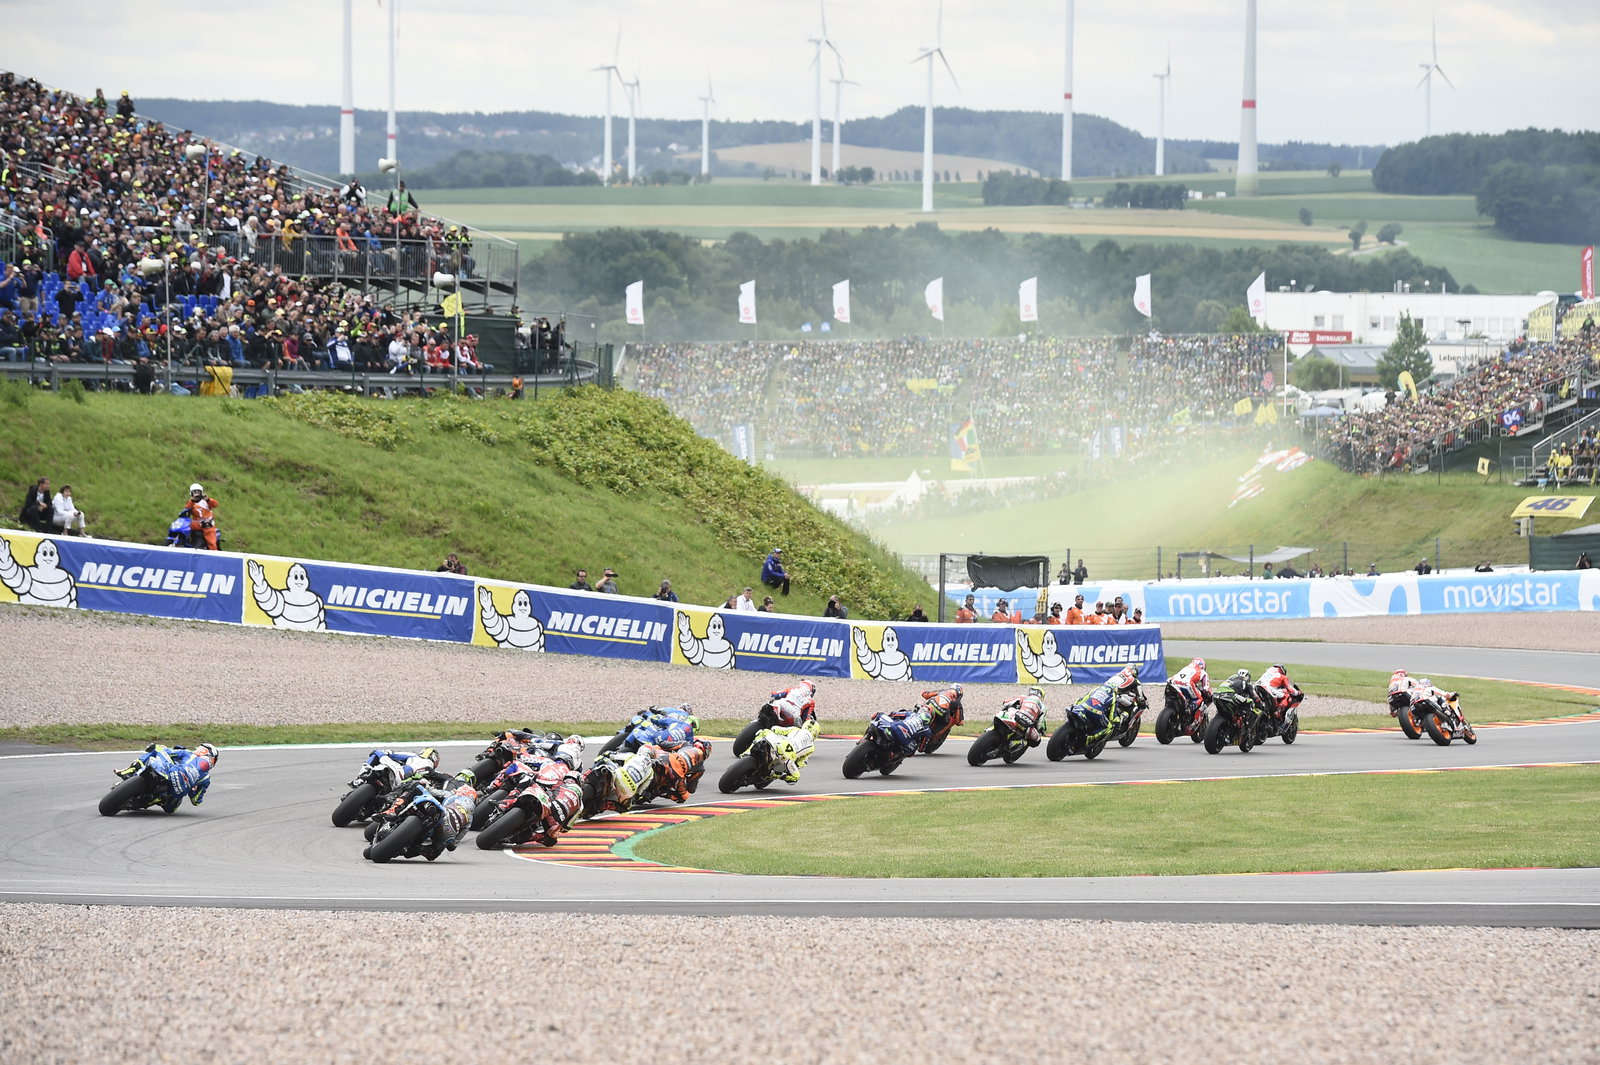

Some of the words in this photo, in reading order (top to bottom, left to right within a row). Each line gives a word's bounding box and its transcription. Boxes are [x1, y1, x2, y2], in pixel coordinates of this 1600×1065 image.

[1526, 498, 1577, 511] 46
[79, 562, 235, 594] MICHELIN
[328, 585, 468, 615] MICHELIN
[1168, 588, 1292, 616] movistar
[1443, 579, 1562, 608] movistar
[547, 611, 667, 641] MICHELIN
[738, 633, 843, 657] MICHELIN
[912, 643, 1013, 661] MICHELIN
[1069, 644, 1158, 662] MICHELIN
